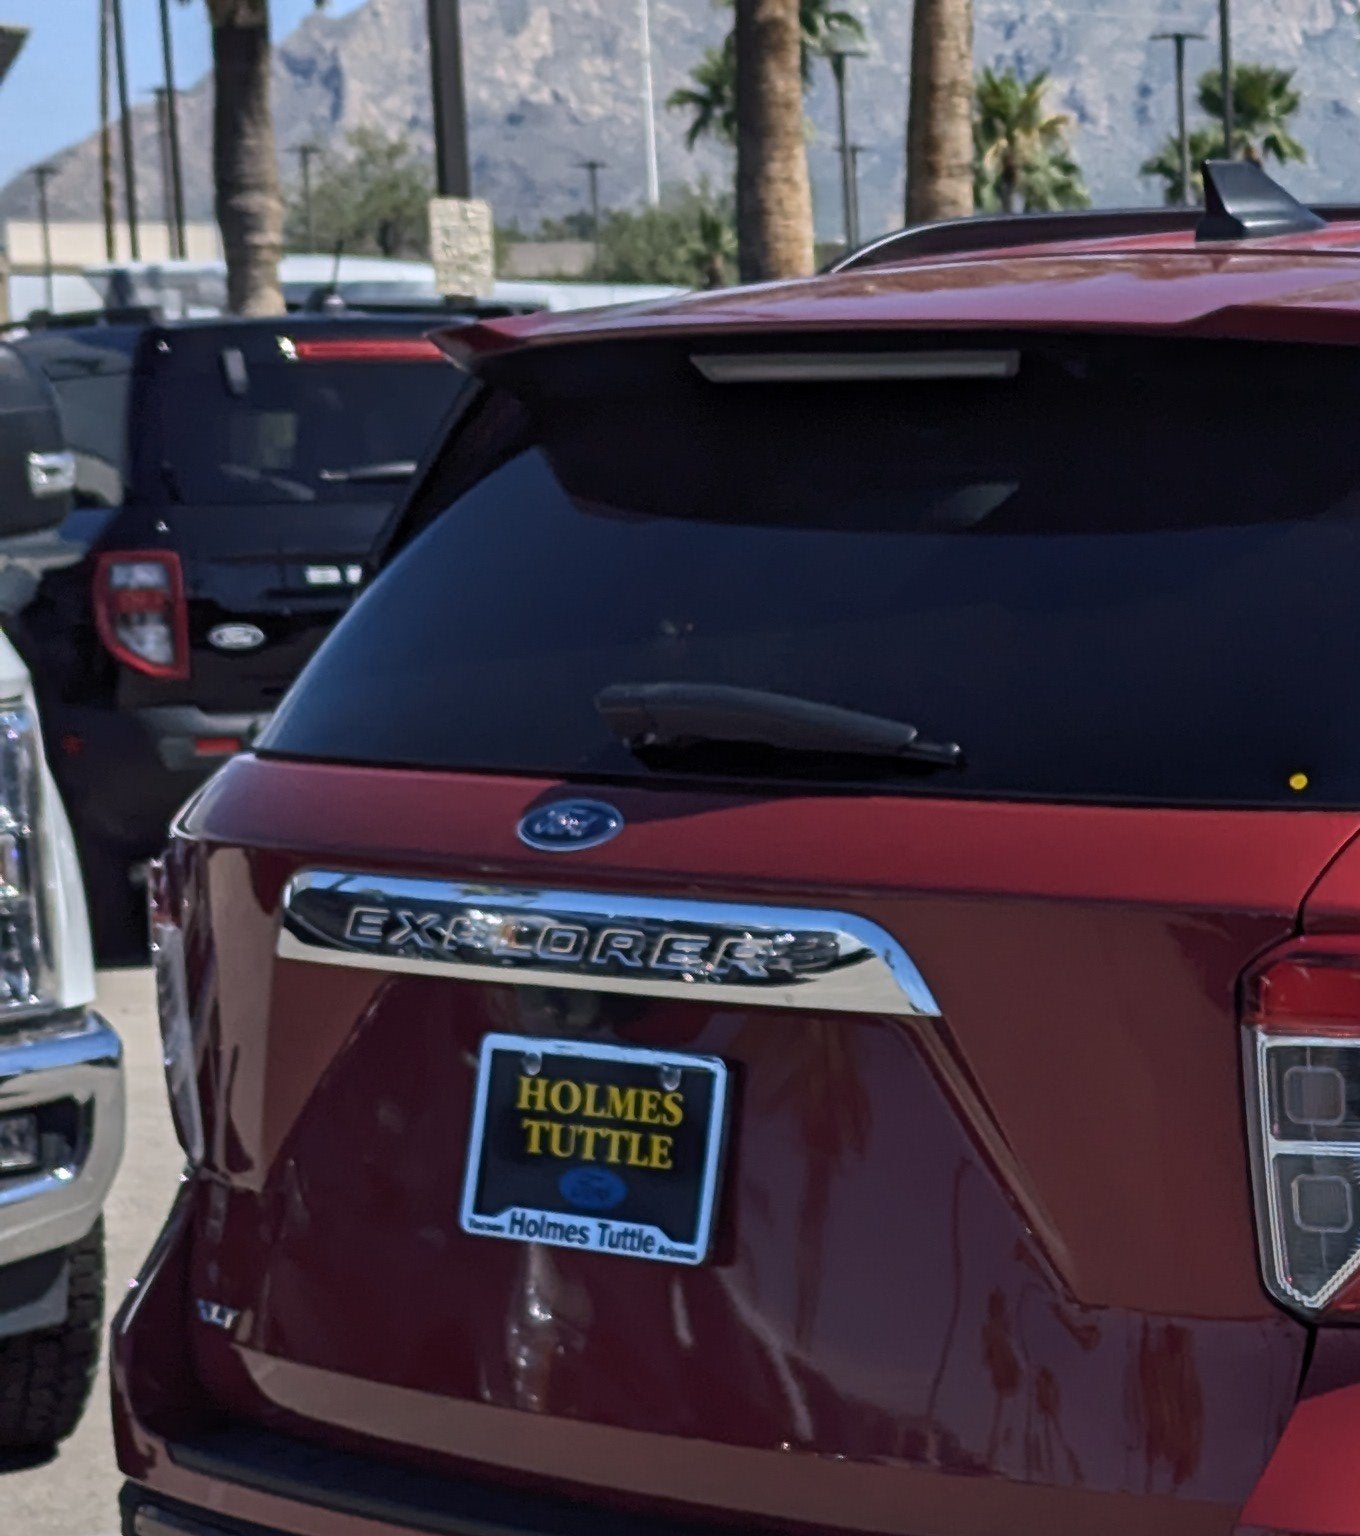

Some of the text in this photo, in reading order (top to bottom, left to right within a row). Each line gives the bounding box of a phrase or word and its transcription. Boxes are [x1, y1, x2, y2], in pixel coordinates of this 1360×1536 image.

[516, 1075, 684, 1127] HOLMES
[522, 1118, 674, 1169] TUTTLE
[508, 1210, 591, 1245] Holmes
[597, 1222, 656, 1253] Tuttle
